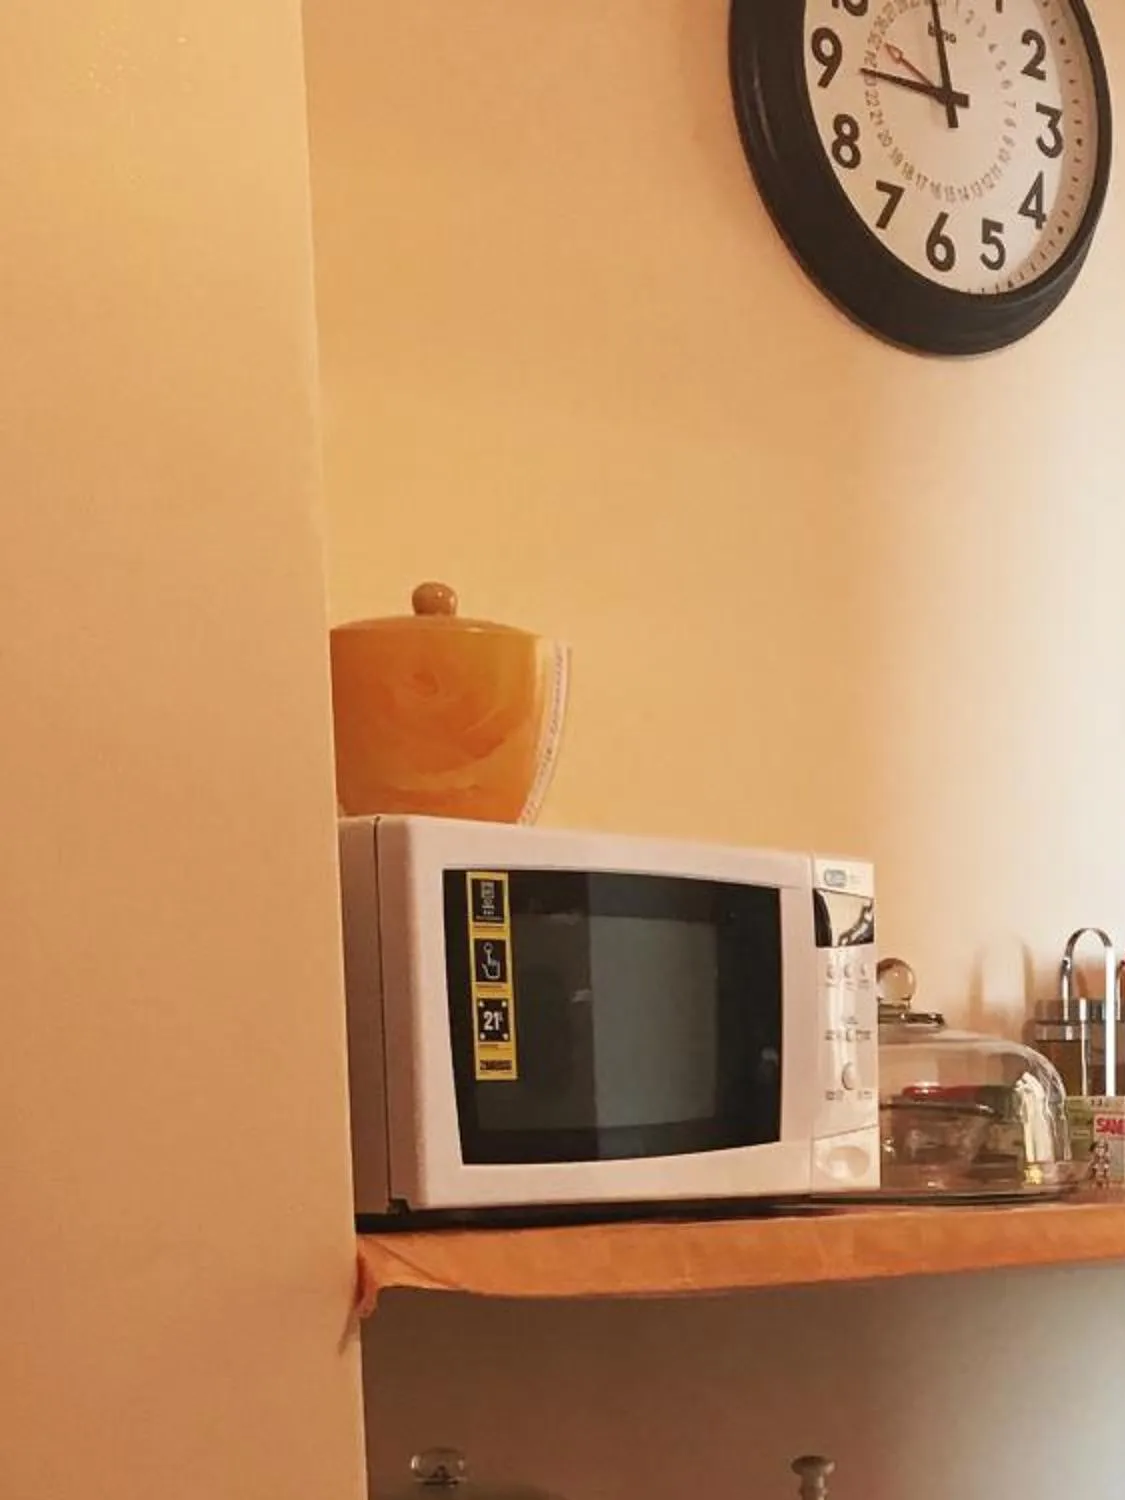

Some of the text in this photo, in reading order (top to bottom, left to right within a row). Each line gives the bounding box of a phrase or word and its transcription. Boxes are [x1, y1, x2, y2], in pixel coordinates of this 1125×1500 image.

[811, 27, 842, 88] 9
[1020, 29, 1047, 81] 2
[831, 114, 861, 169] 8
[1036, 102, 1064, 159] 3
[875, 180, 905, 230] 7
[1018, 171, 1047, 230] 4
[925, 212, 955, 272] 6
[980, 218, 1007, 271] 5
